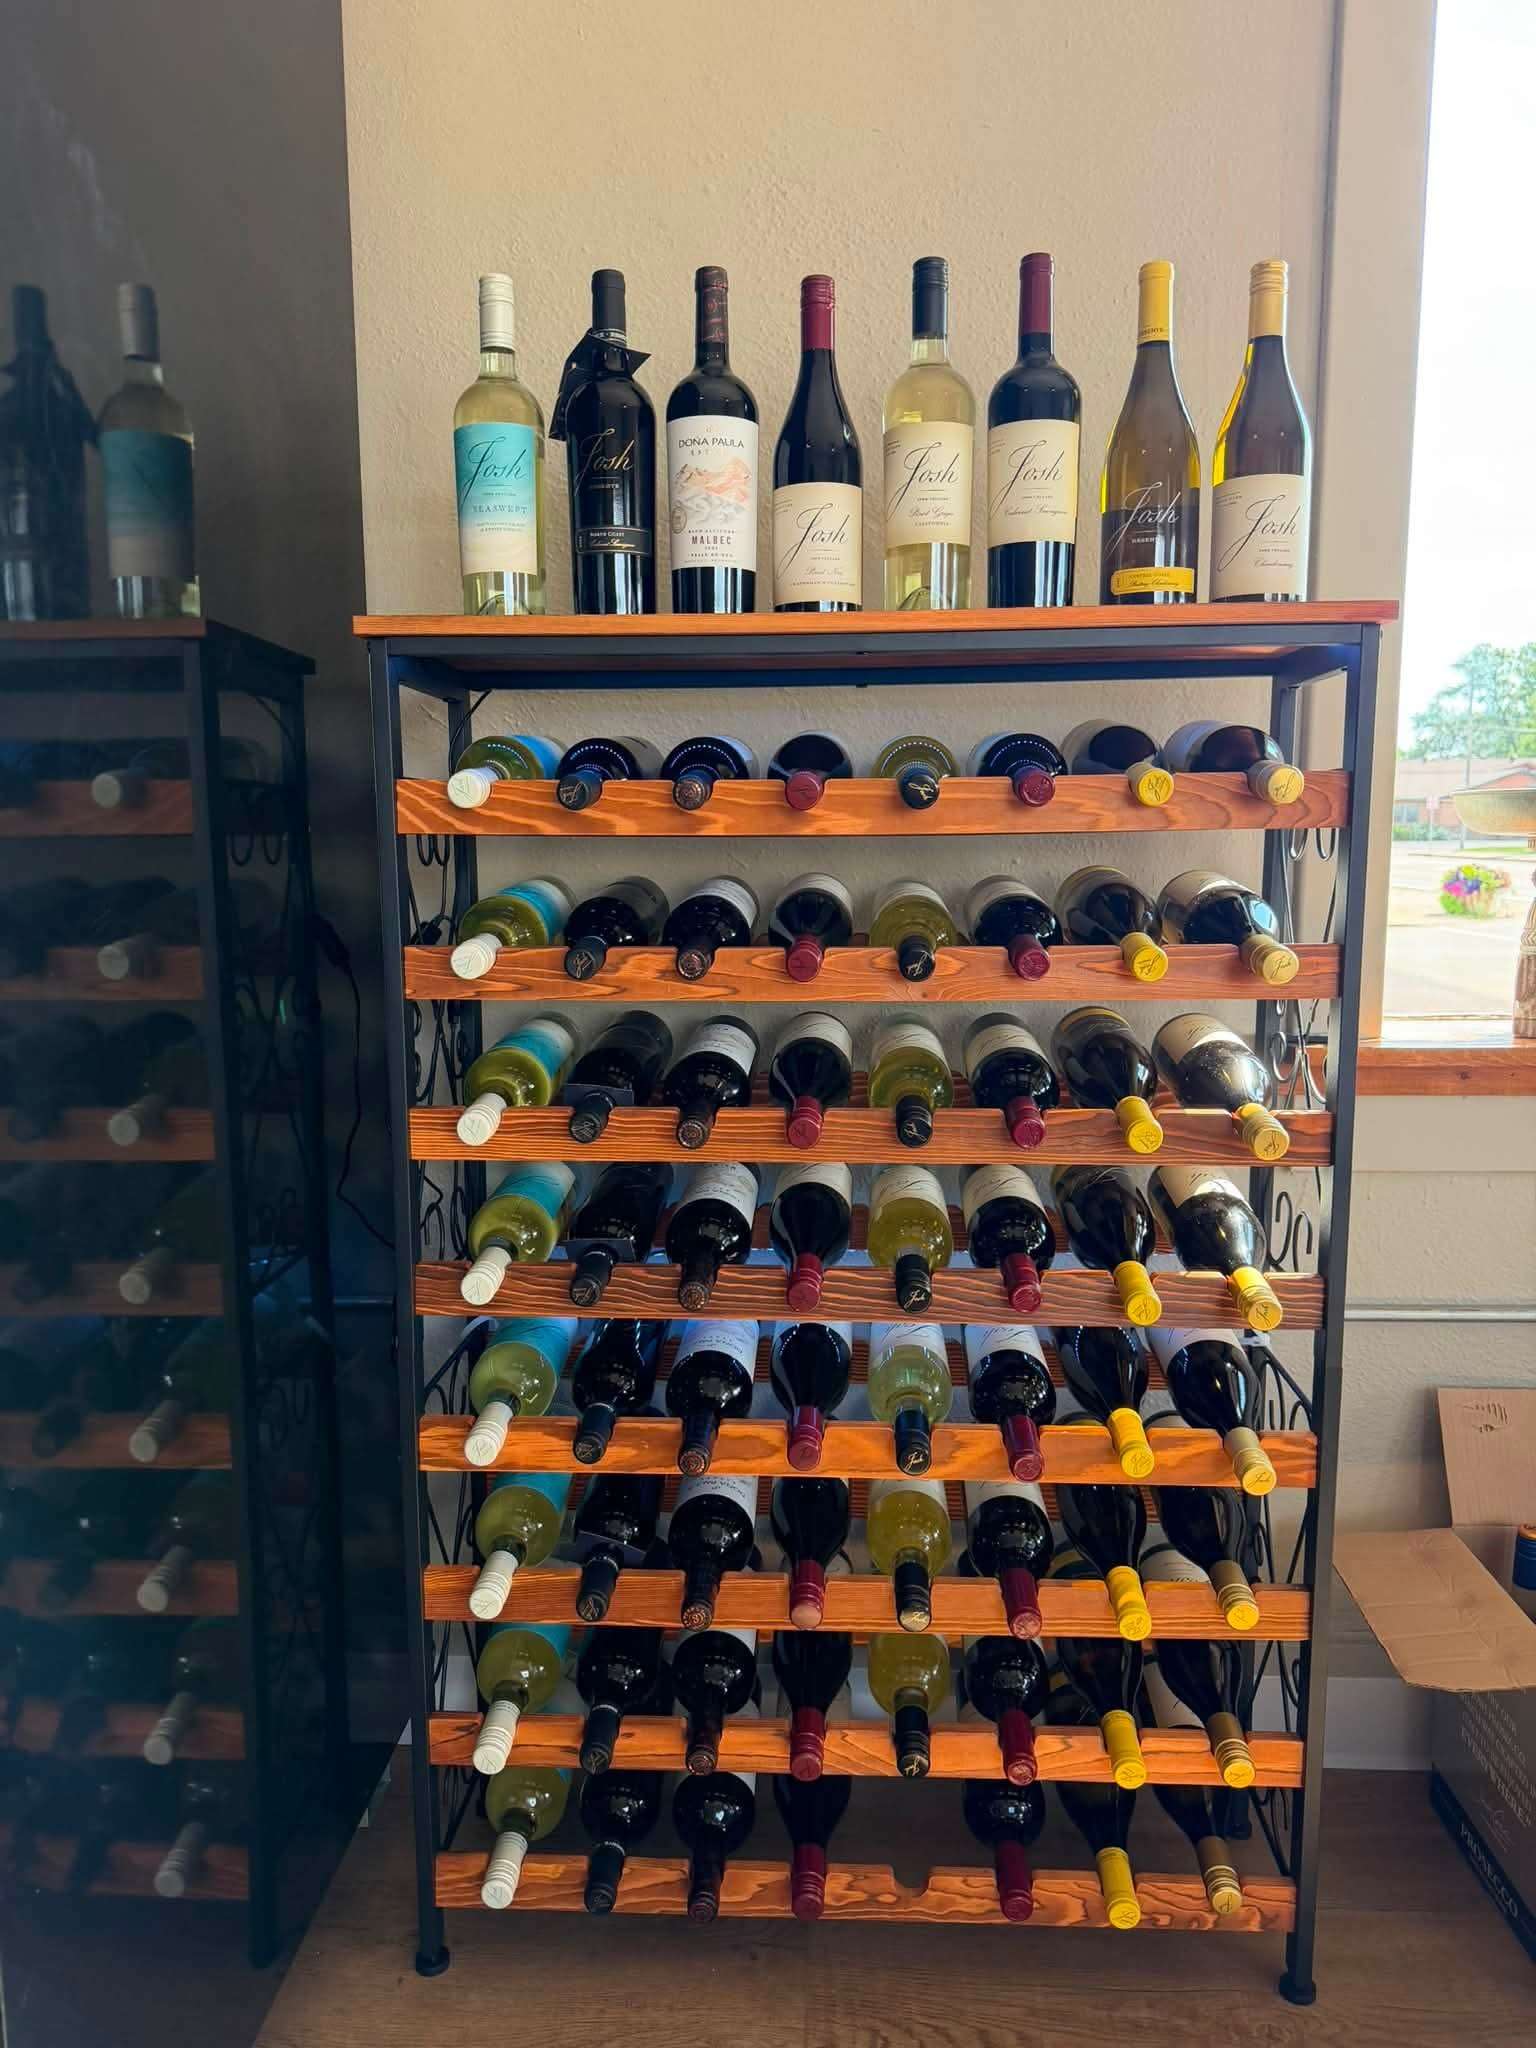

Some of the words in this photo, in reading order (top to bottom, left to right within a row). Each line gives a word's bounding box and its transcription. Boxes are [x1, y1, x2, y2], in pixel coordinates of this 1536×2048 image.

[459, 436, 527, 511] Josh
[574, 428, 635, 497] Josh
[678, 438, 709, 449] DOÑA
[711, 437, 745, 449] PAULA
[886, 441, 960, 523] Josh
[988, 439, 1064, 521] Josh
[691, 535, 733, 545] MALBEC
[775, 502, 852, 581] Josh
[1105, 481, 1182, 560] Josh
[1216, 494, 1300, 573] Josh
[1460, 1822, 1519, 1919] PROSECCO
